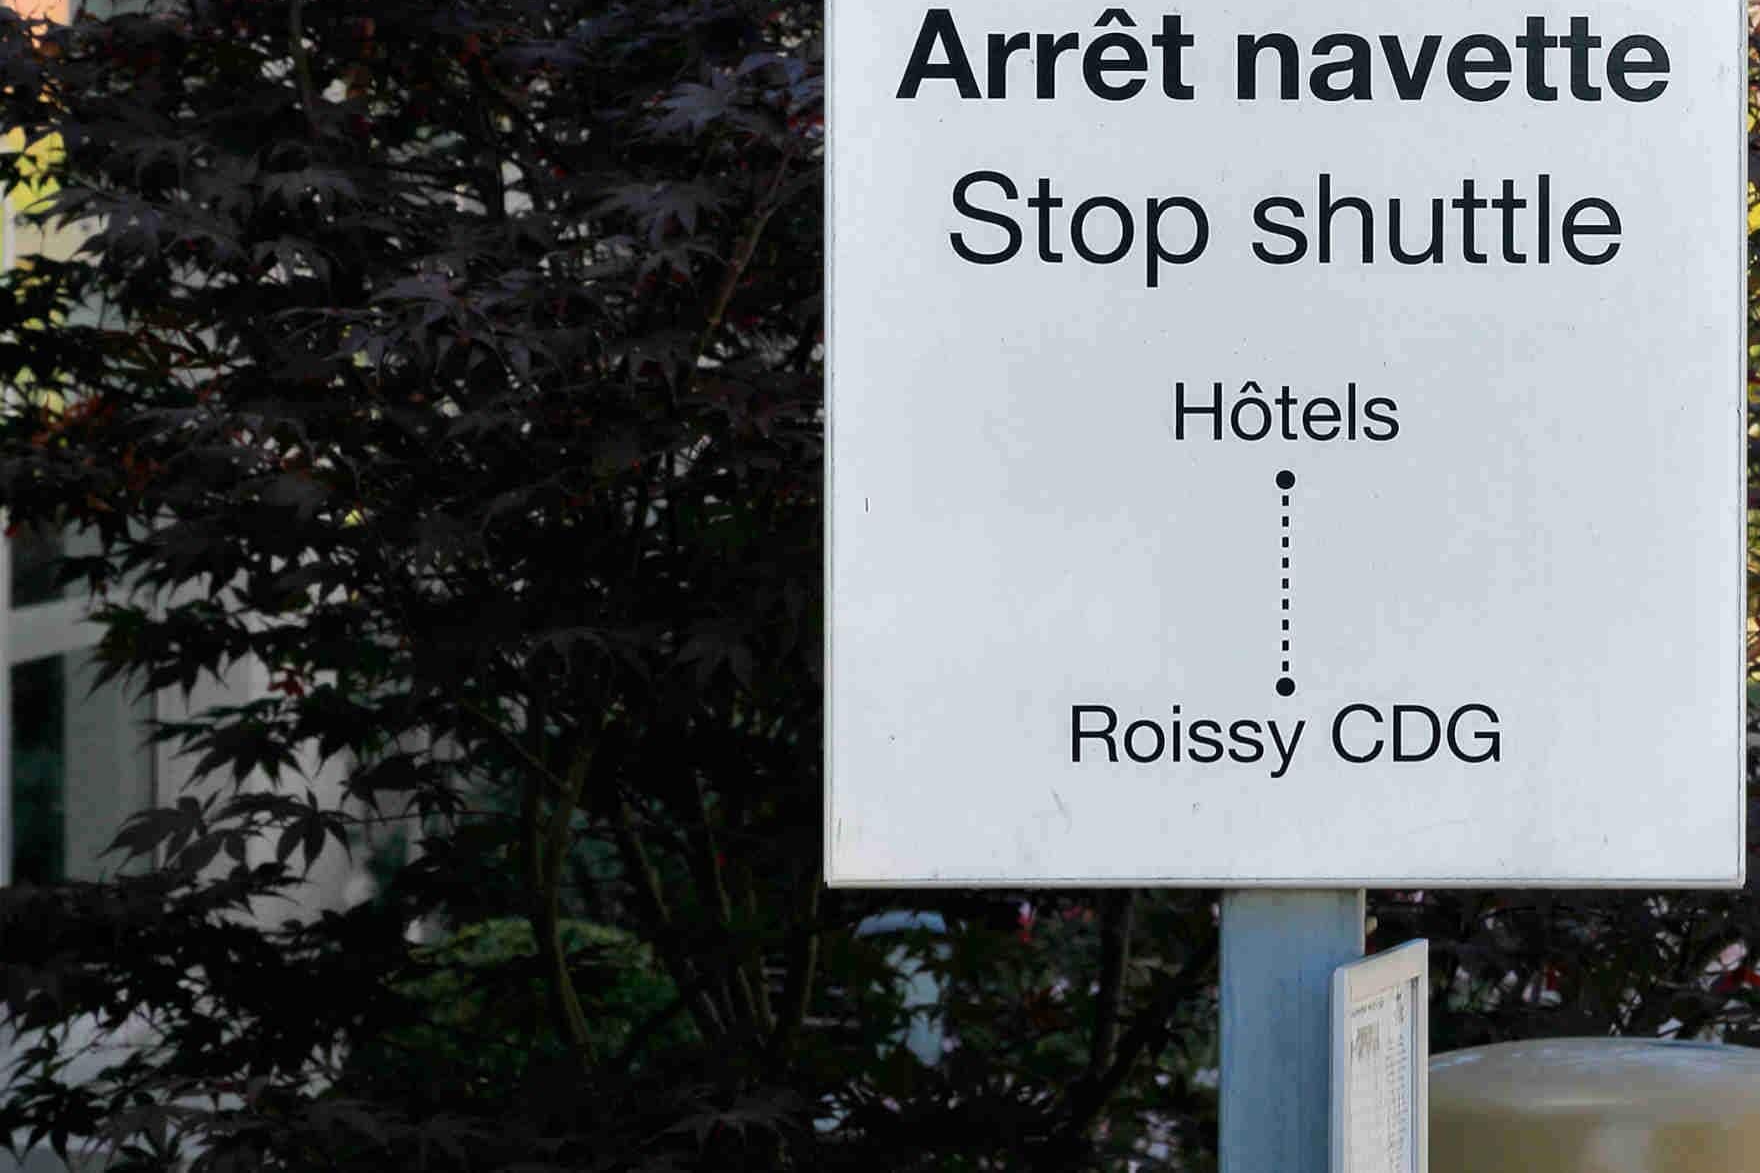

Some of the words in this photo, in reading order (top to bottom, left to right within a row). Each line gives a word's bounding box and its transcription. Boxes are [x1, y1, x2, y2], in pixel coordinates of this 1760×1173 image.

[896, 8, 1195, 101] Arrêt
[1237, 16, 1671, 103] navette
[949, 170, 1209, 288] Stop
[1251, 173, 1622, 266] shuttle
[1175, 380, 1400, 442] Hôtels
[1071, 704, 1306, 779] Roissy
[1331, 703, 1501, 764] CDG
